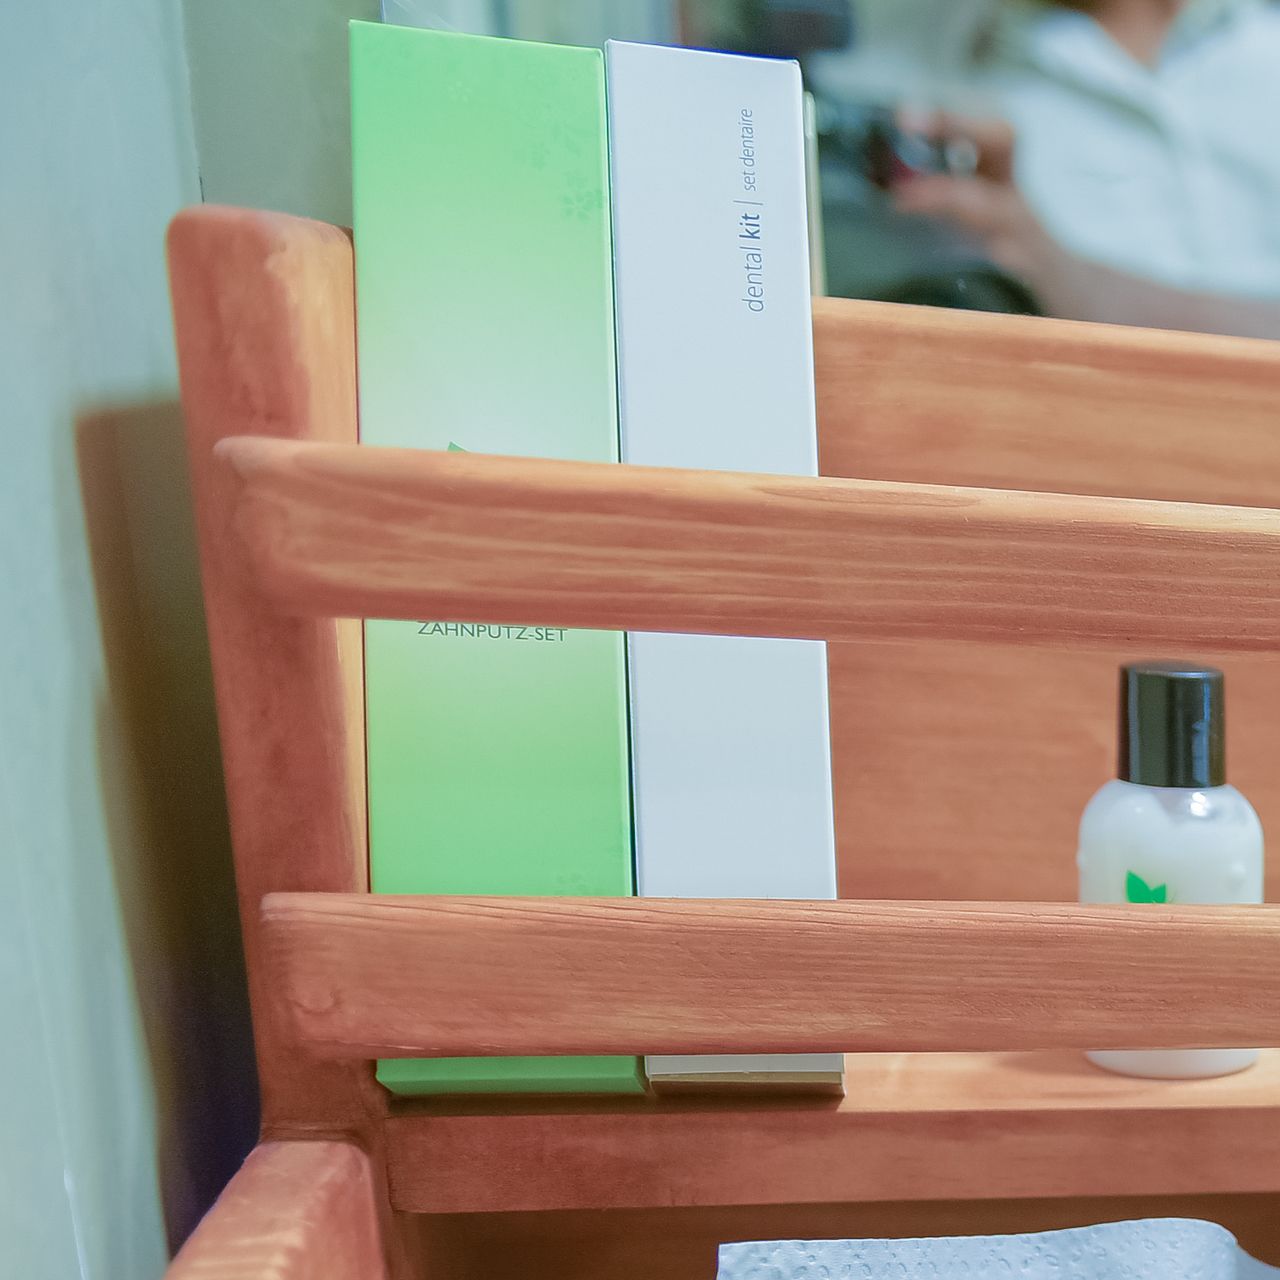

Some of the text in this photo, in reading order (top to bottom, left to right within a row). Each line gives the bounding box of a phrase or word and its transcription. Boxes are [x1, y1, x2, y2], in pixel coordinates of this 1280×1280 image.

[738, 108, 764, 312] dental kit set dentaire
[417, 620, 568, 642] ZAHNPUTZ-SET
